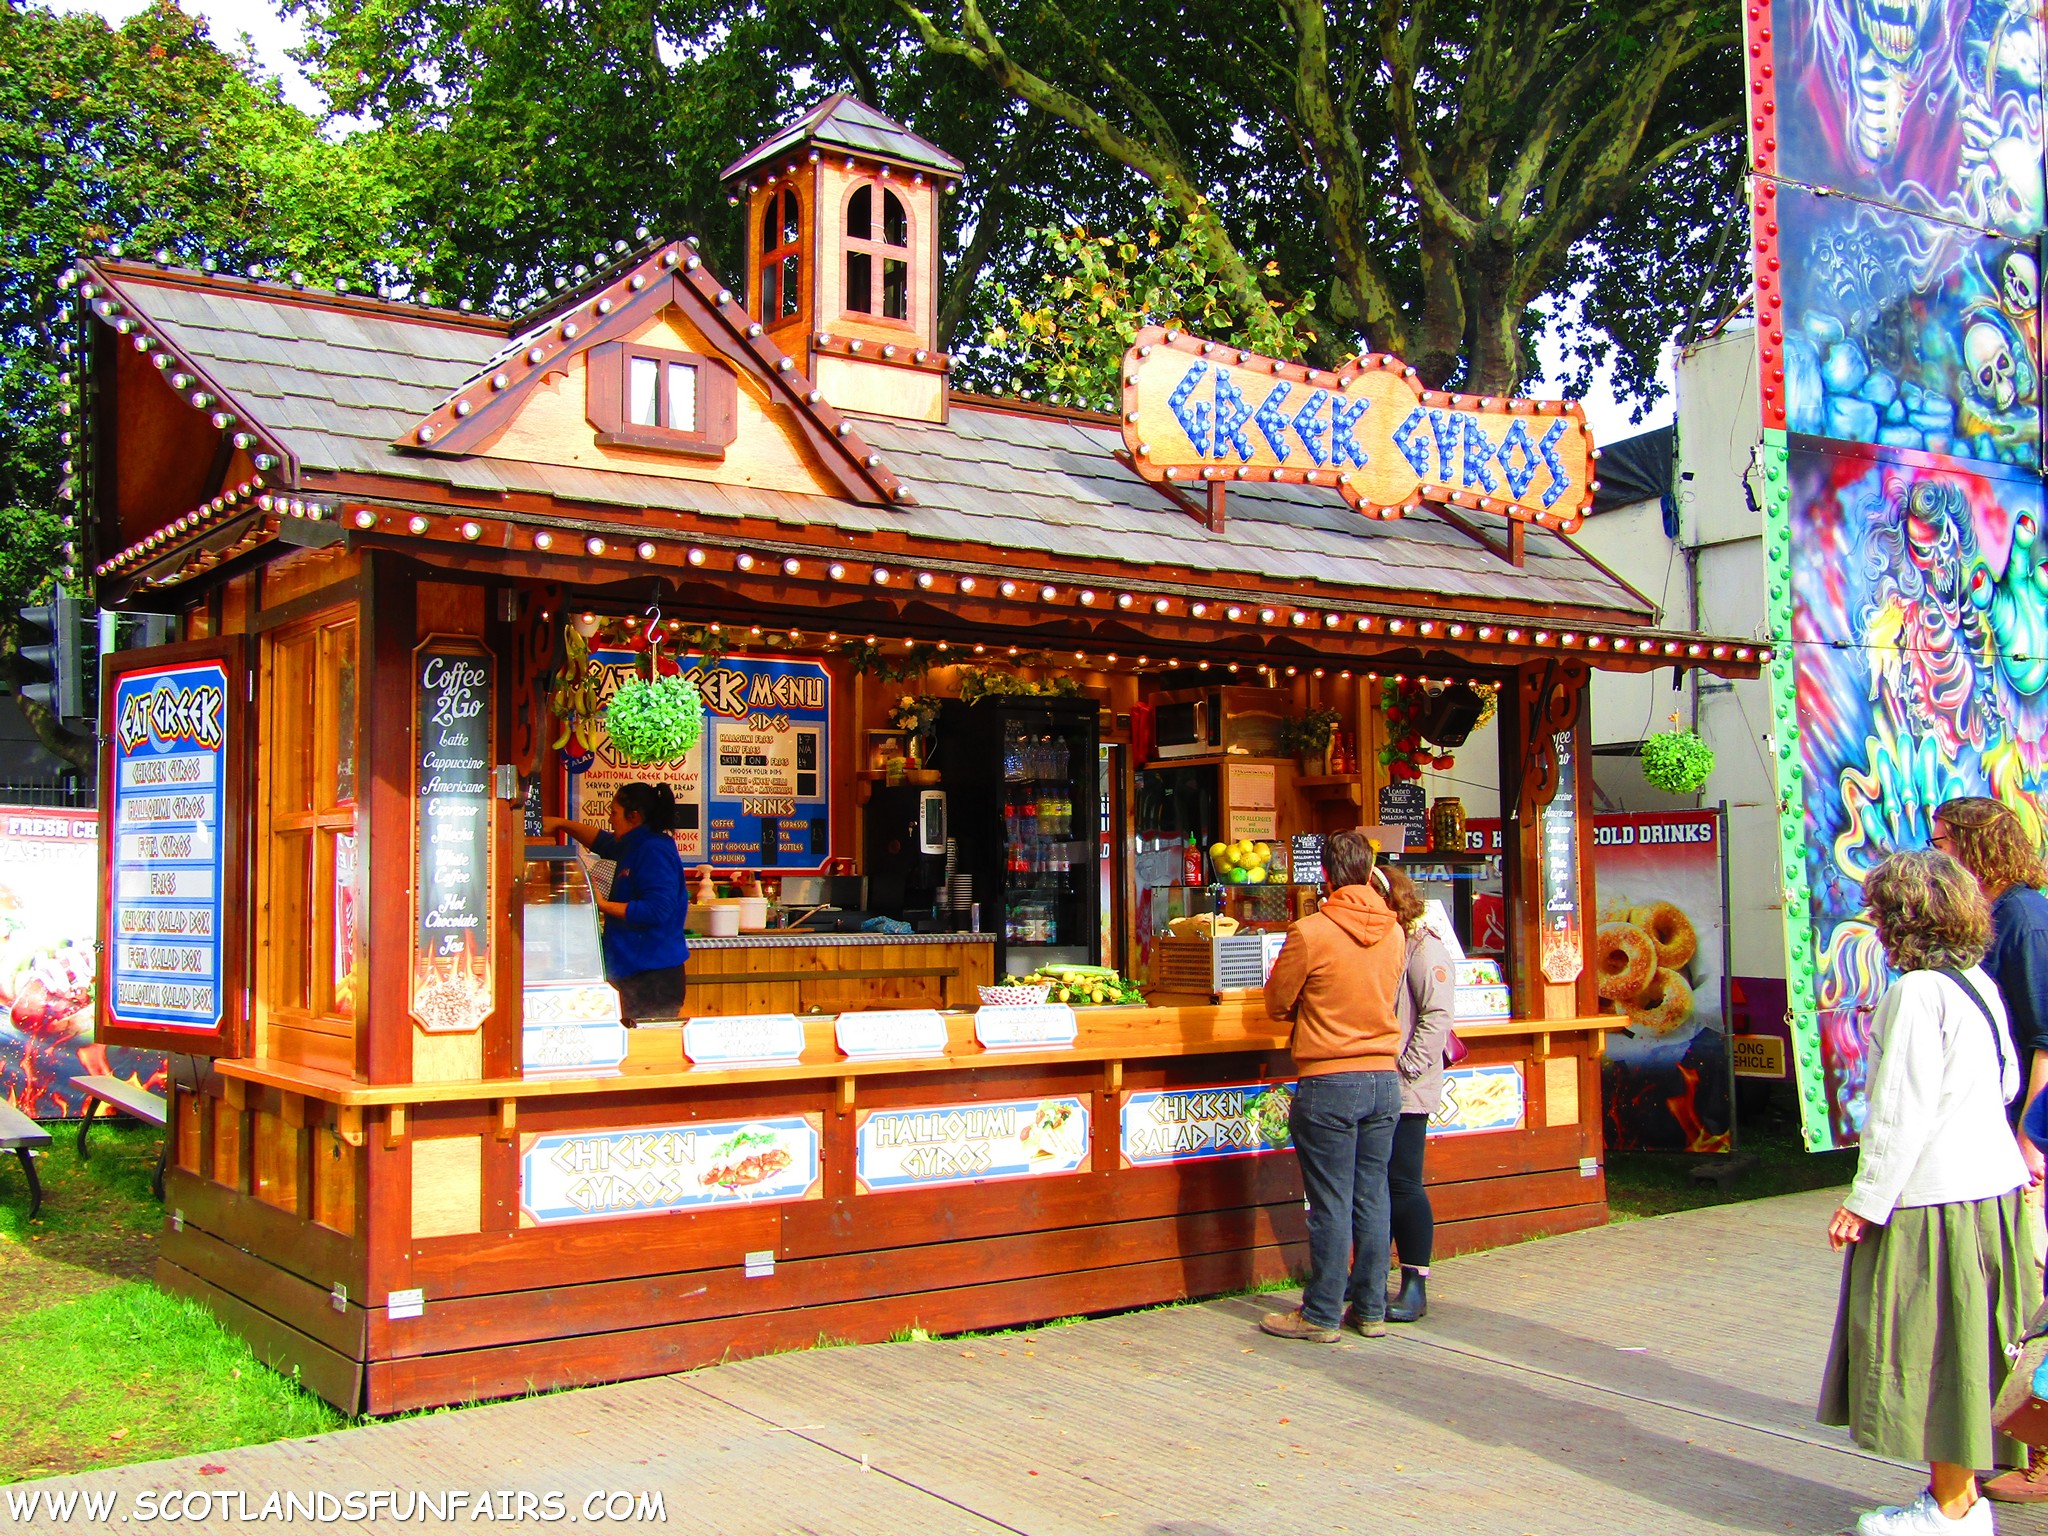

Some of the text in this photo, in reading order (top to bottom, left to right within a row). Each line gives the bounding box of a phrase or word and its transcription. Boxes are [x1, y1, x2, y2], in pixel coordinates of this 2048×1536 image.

[1168, 360, 1571, 508] GREEK GYROS
[423, 657, 486, 696] Coffee
[748, 674, 824, 708] MENU
[432, 688, 485, 727] 2Go
[119, 687, 223, 752] EAT GREEK
[748, 713, 790, 732] SIDES
[439, 730, 469, 747] Latte
[720, 734, 753, 743] HALLOUMI
[754, 735, 774, 744] FRIES
[720, 745, 740, 754] CURLY
[742, 745, 761, 754] FRIES
[133, 758, 200, 784] CHICKEN GYROS
[423, 751, 486, 771] Cappuccino
[721, 756, 739, 764] SKIN
[749, 757, 761, 765] ON
[770, 758, 790, 766] FRIES
[421, 775, 486, 794] Americano
[583, 771, 698, 781] TRADITIONAL GREEK DELICACY
[585, 781, 611, 789] SERVED
[719, 785, 735, 793] SOUR
[735, 785, 755, 794] CREAM
[128, 796, 206, 820] HALLOUMI GYROS
[428, 797, 479, 818] Espresso
[742, 798, 796, 817] DRINKS
[1542, 805, 1574, 820] Americano
[8, 817, 69, 837] FRESH
[431, 823, 474, 843] Mocha
[711, 819, 735, 829] COFFEE
[779, 820, 809, 829] ESPRESSO
[1546, 821, 1571, 835] Espresso
[1639, 823, 1712, 844] DRINKS
[673, 833, 699, 841] HOICE
[711, 831, 730, 840] LATTE
[779, 832, 790, 840] TEA
[138, 835, 191, 857] FETA GYROS
[711, 843, 760, 852] HOT CHOCOLATE
[779, 843, 804, 852] BOTTLES
[435, 850, 469, 866] White
[151, 873, 177, 895] FRIES
[434, 866, 470, 887] Coffee
[438, 893, 466, 913] Hot
[122, 910, 210, 934] CHICKEN SALAD BOX
[425, 910, 479, 928] Chocolate
[1555, 915, 1567, 930] Tea
[439, 935, 464, 955] Tea
[128, 947, 202, 972] FETA SALAD BOX
[118, 983, 212, 1011] HALLOUMI SALAD BOX
[541, 1026, 586, 1046] FETA
[532, 1045, 595, 1067] GYROS
[1734, 1042, 1764, 1055] ONG
[1734, 1056, 1774, 1068] EHICLE
[1148, 1091, 1245, 1125] CHICKEN
[875, 1108, 1016, 1147] HALLOUMI
[1130, 1120, 1262, 1159] SALAD BOX
[550, 1132, 696, 1174] CHICKEN
[900, 1142, 992, 1178] GYROS
[565, 1169, 684, 1211] GYROS
